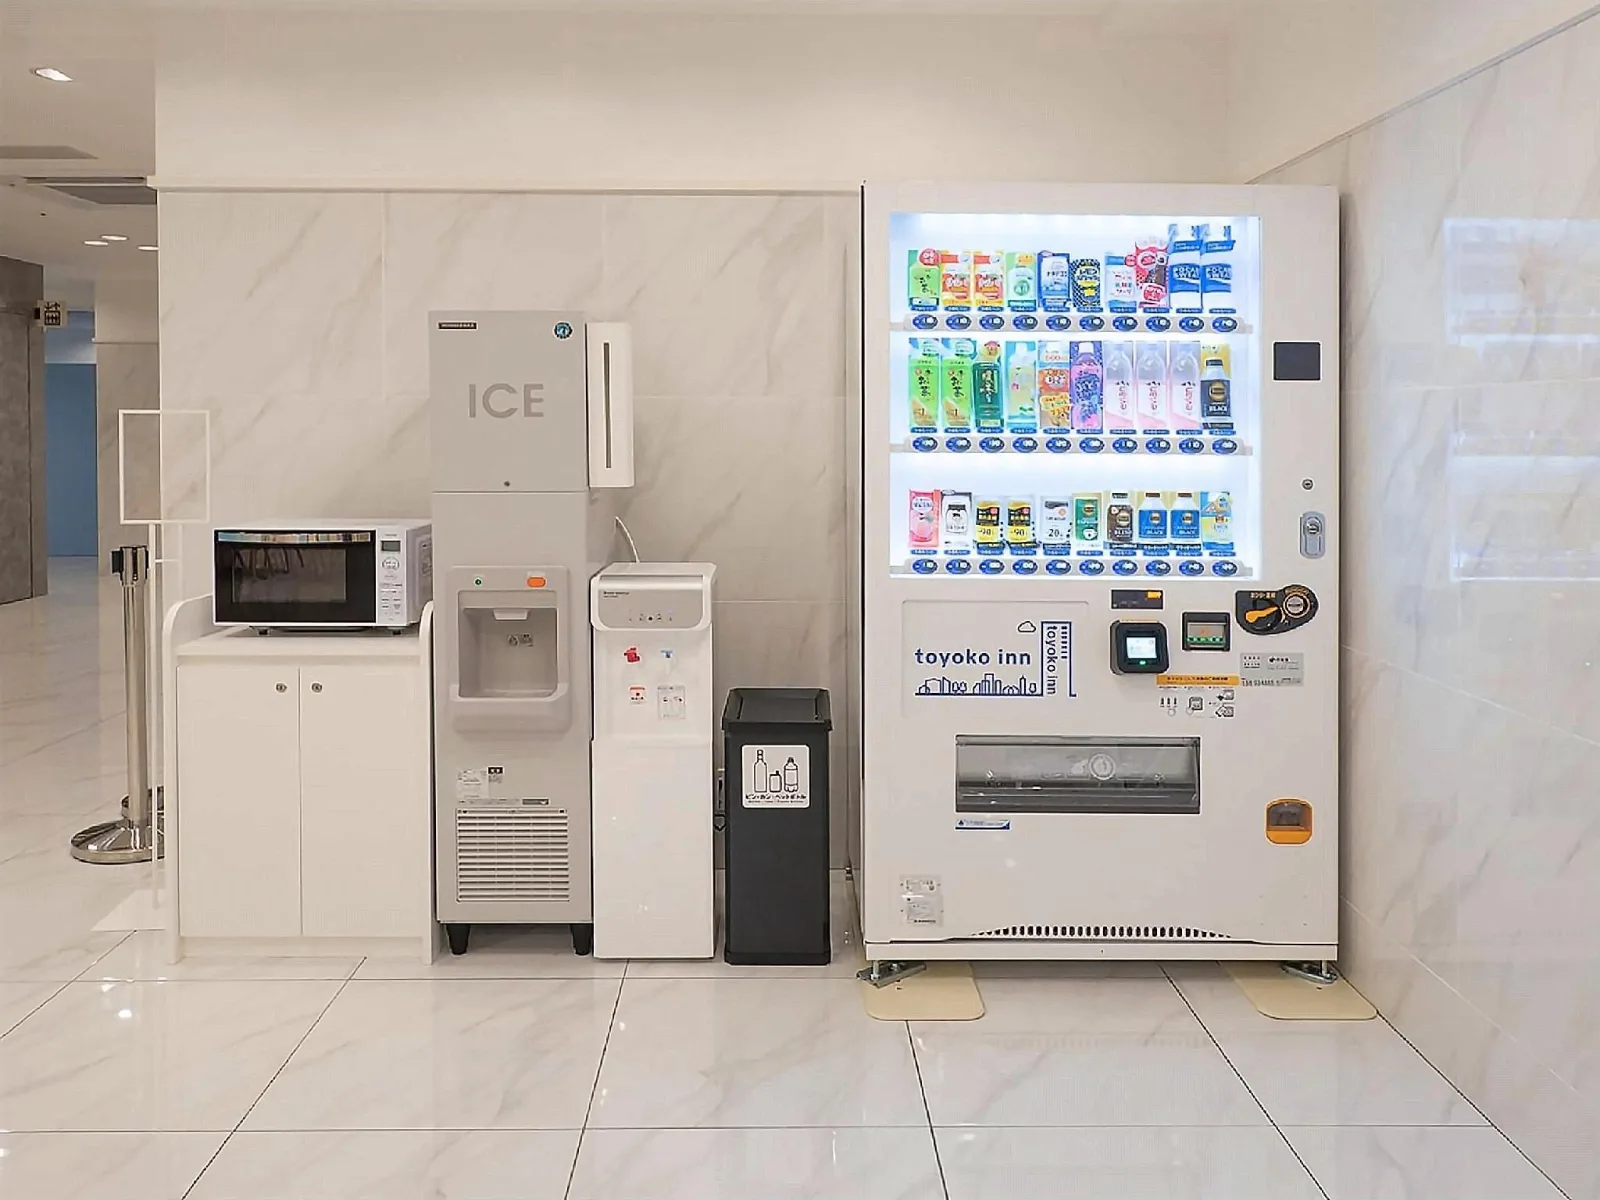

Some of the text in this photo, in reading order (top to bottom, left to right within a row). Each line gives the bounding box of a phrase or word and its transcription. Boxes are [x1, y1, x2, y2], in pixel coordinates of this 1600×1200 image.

[468, 383, 544, 419] ICE
[914, 648, 1031, 668] toyoko inn
[1046, 625, 1059, 695] toyoko inn
